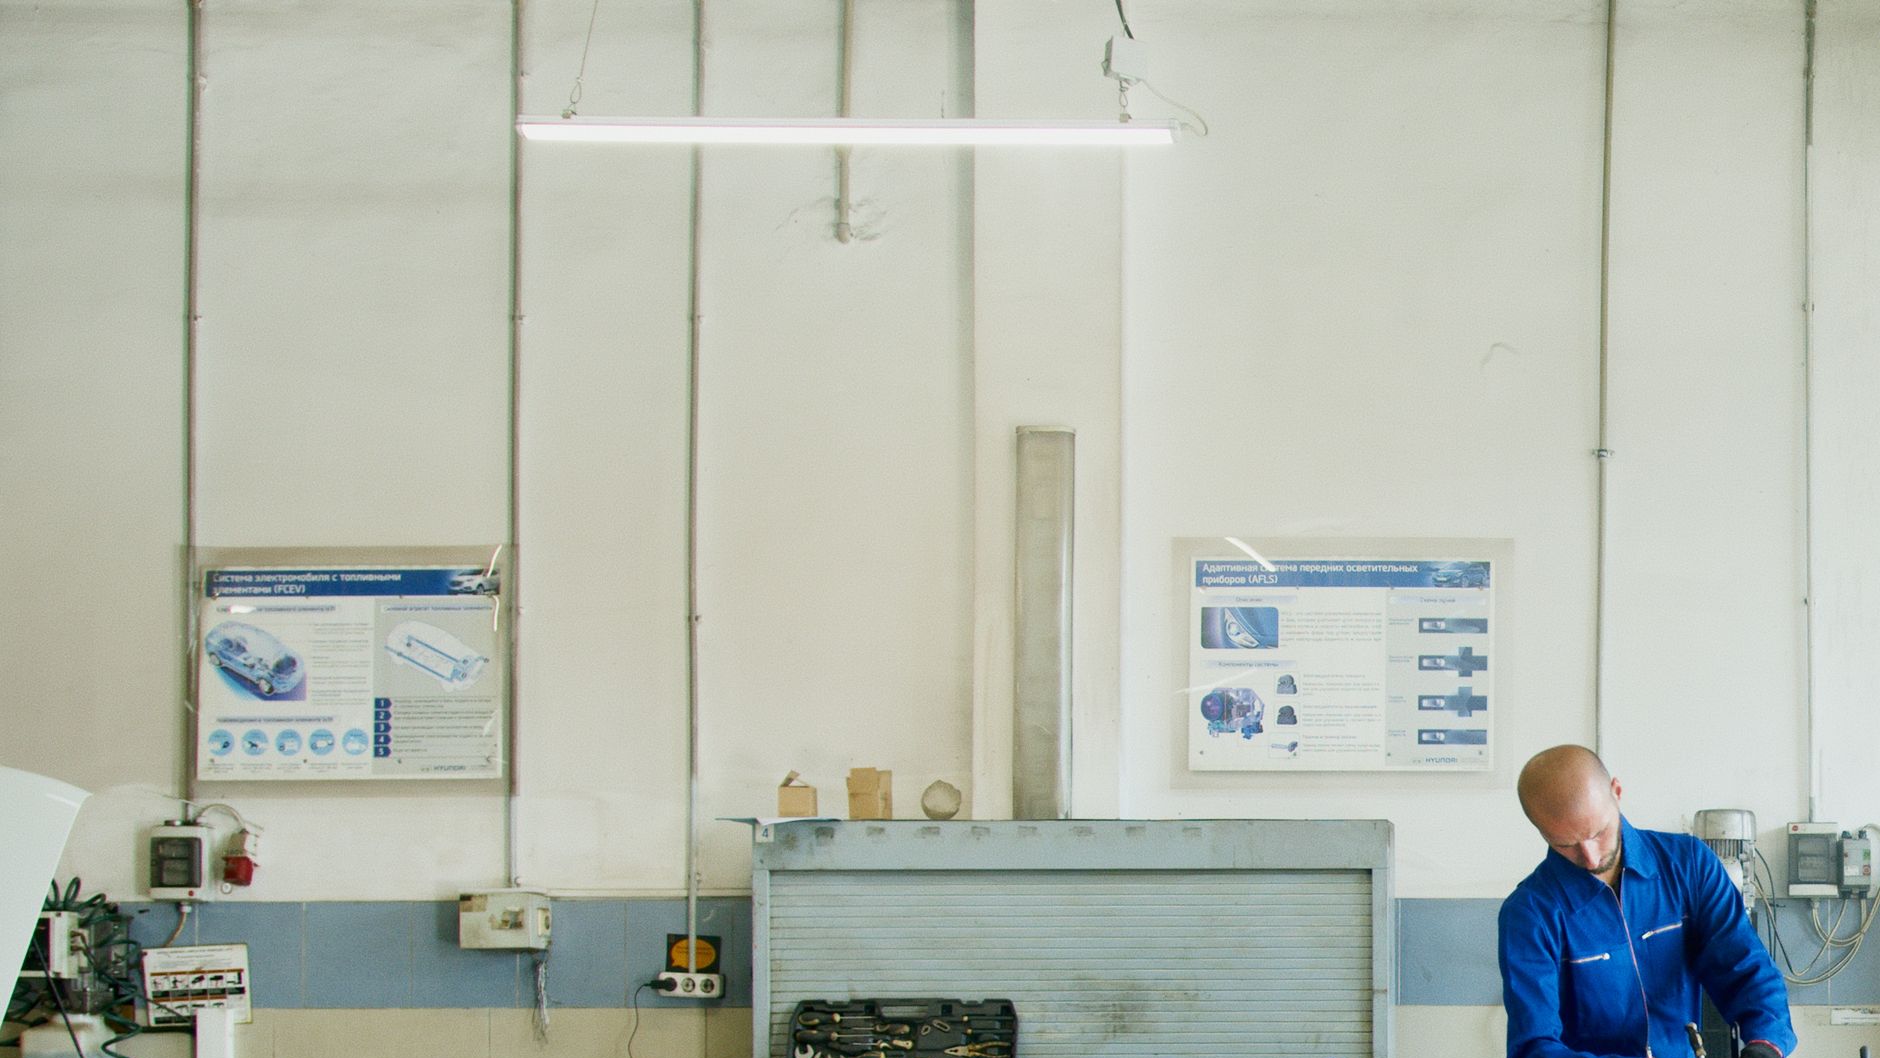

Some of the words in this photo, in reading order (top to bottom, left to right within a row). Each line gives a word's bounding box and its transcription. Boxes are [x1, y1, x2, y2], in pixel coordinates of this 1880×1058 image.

[1203, 563, 1257, 574] Адаптивная
[1300, 565, 1344, 575] передних
[1346, 563, 1418, 573] осветительных
[255, 572, 330, 584] электромобиля
[340, 574, 401, 582] топливными
[1203, 575, 1246, 585] приборов
[1248, 574, 1278, 585] (AFLS)
[274, 584, 305, 594] (FCEV)
[762, 826, 769, 838] 4
